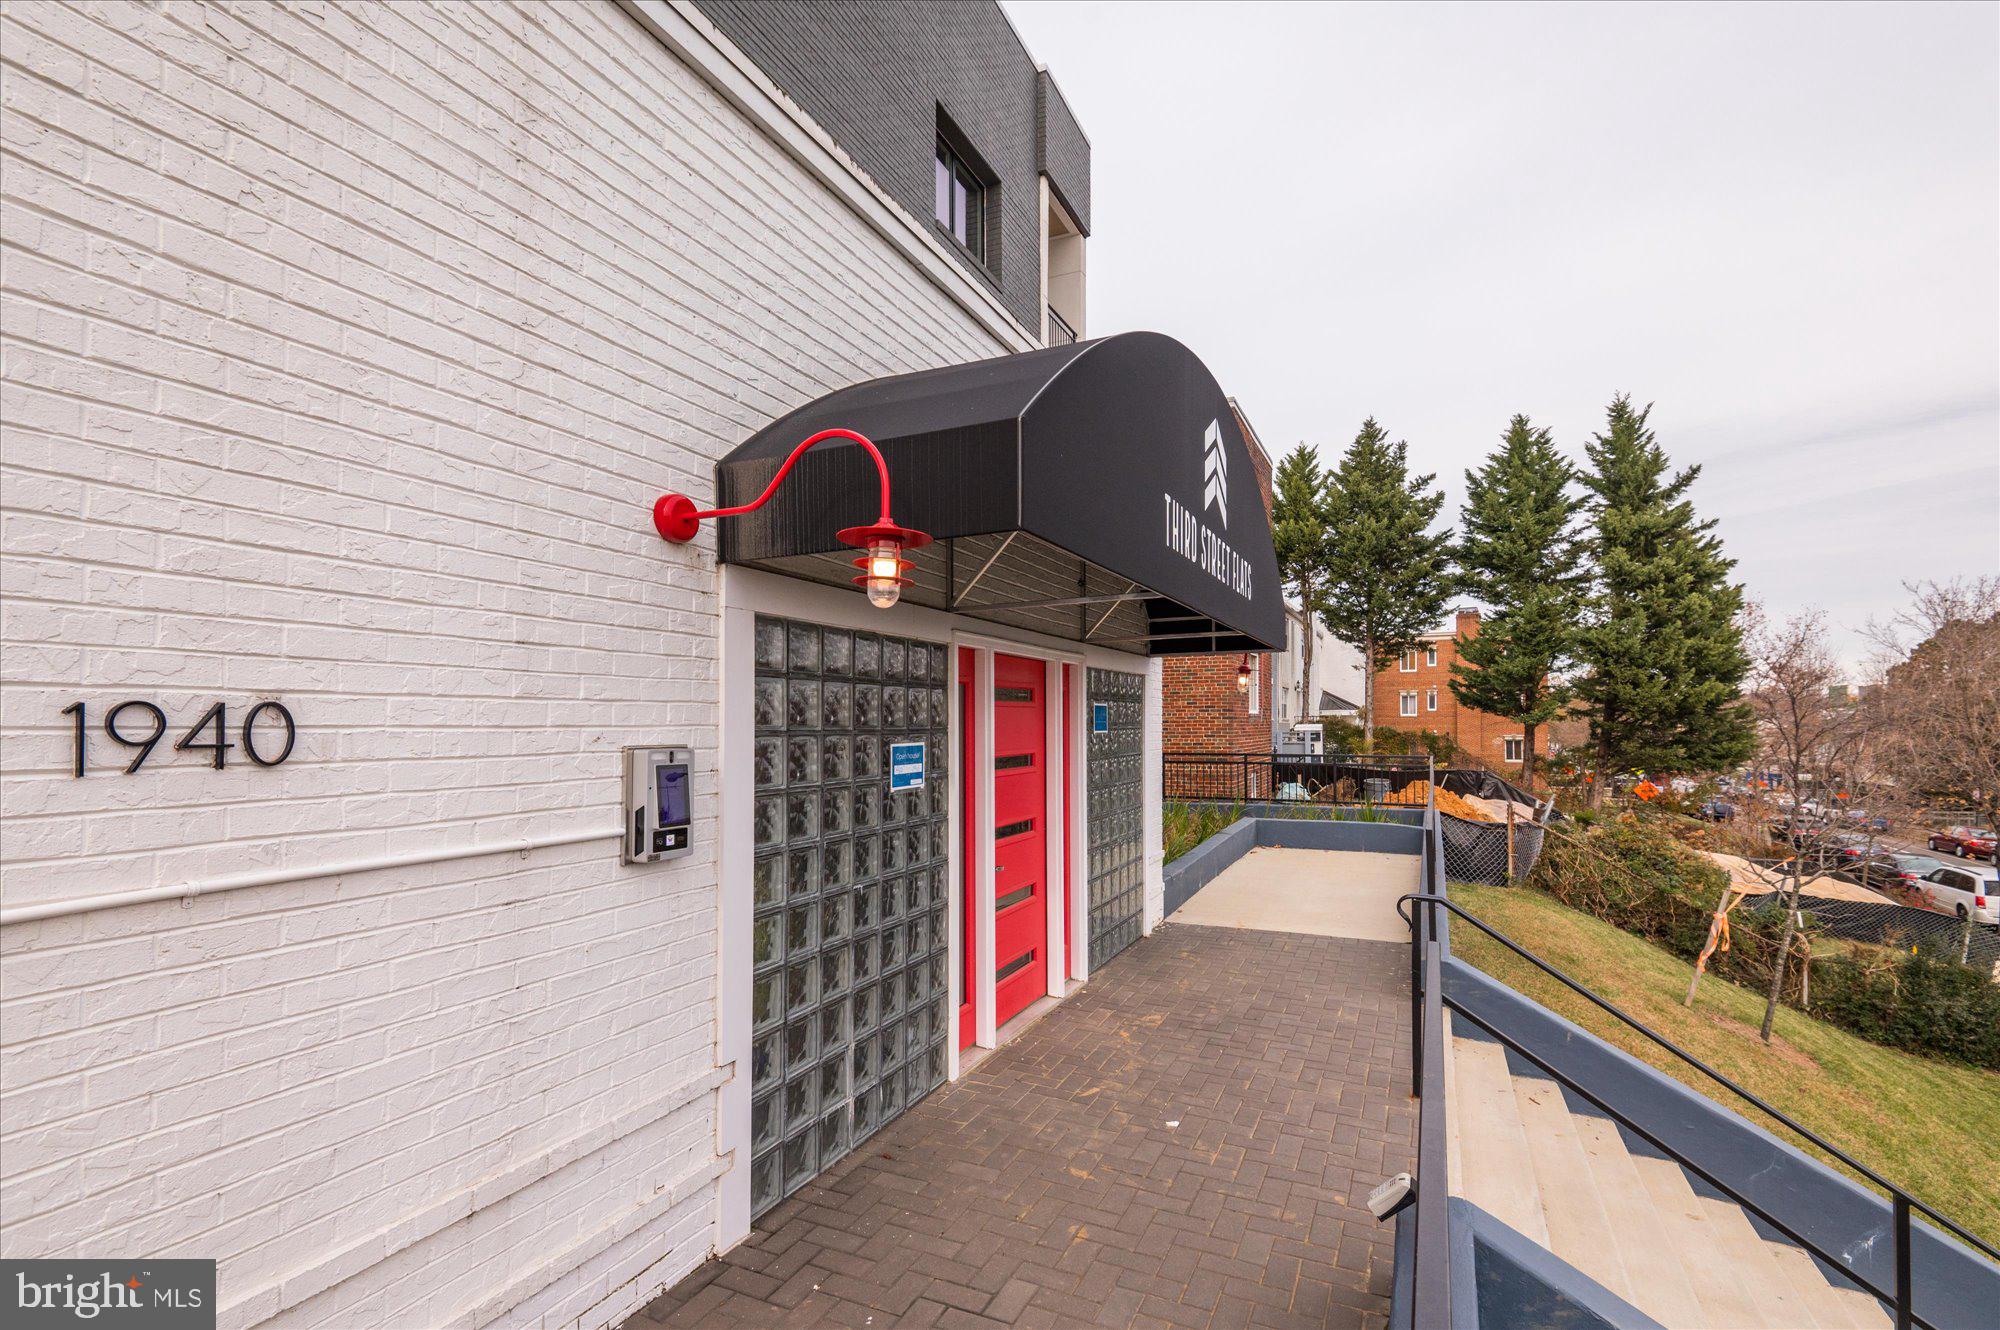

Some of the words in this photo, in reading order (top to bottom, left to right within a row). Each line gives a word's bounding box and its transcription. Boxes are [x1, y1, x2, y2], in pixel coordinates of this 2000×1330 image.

[1164, 493, 1198, 563] THIRD
[1201, 524, 1231, 586] STREET
[1232, 551, 1253, 600] FLATS
[61, 700, 296, 778] 1940
